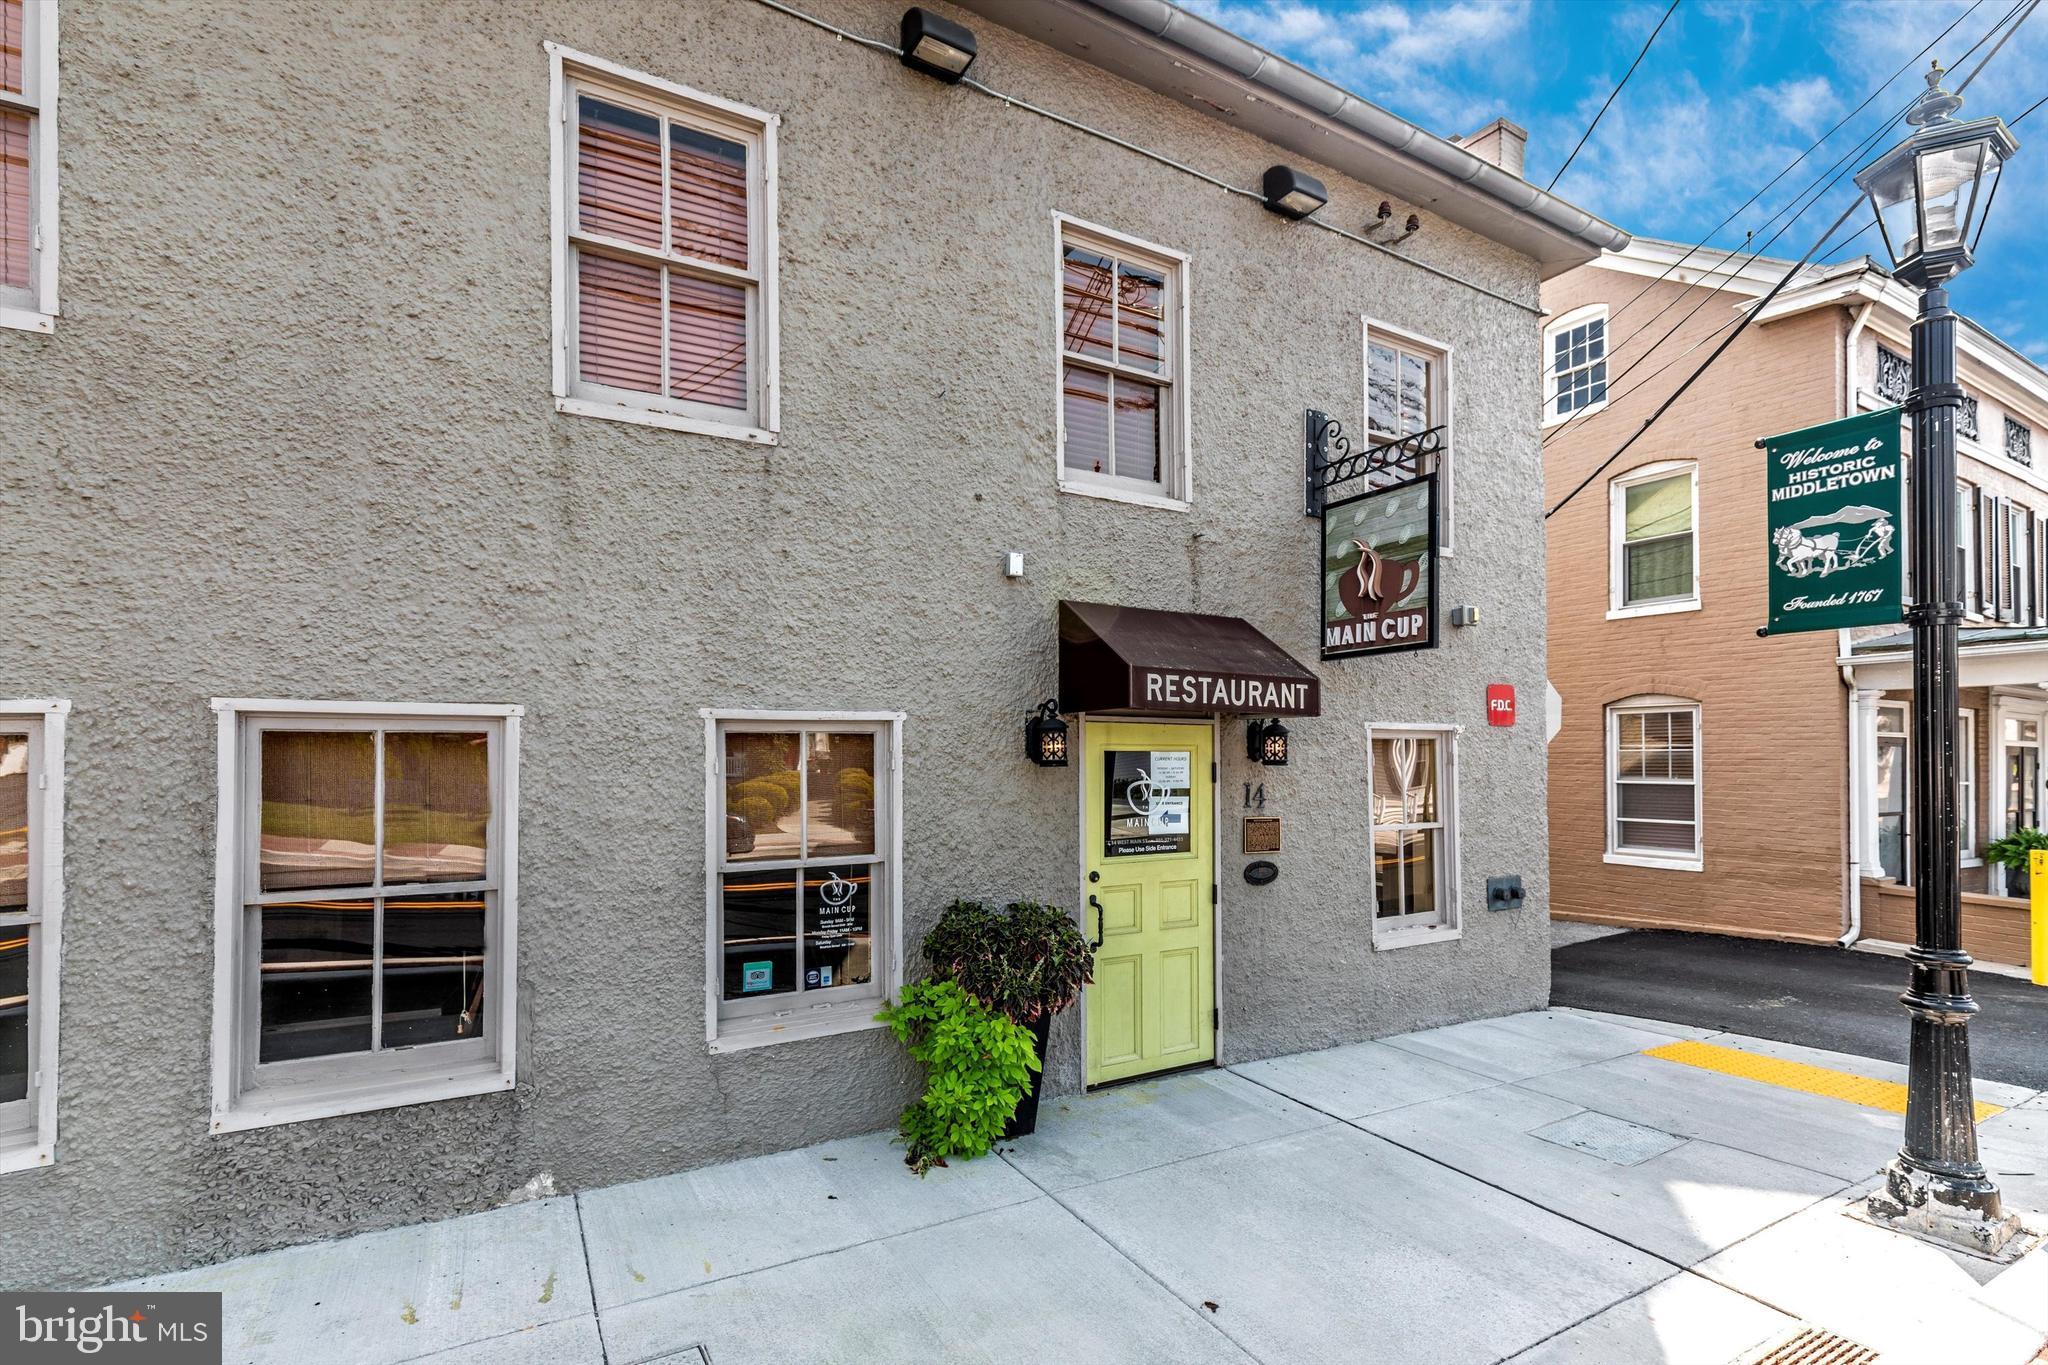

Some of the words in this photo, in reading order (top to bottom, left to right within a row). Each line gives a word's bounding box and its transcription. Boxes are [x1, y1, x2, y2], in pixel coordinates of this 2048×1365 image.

[1780, 444, 1860, 470] Welcome
[1864, 436, 1883, 451] to
[1771, 464, 1895, 502] MIDDLETOWN
[1788, 456, 1876, 484] HISTORIC
[1783, 591, 1845, 611] Founded
[1848, 588, 1884, 604] 1767
[1326, 621, 1376, 647] MAIN
[1381, 614, 1423, 640] CUP
[1147, 673, 1308, 709] RESTAURANT
[1243, 782, 1267, 808] 14
[1126, 817, 1150, 828] MAIN
[819, 906, 839, 915] MAIN
[841, 905, 856, 913] CUP
